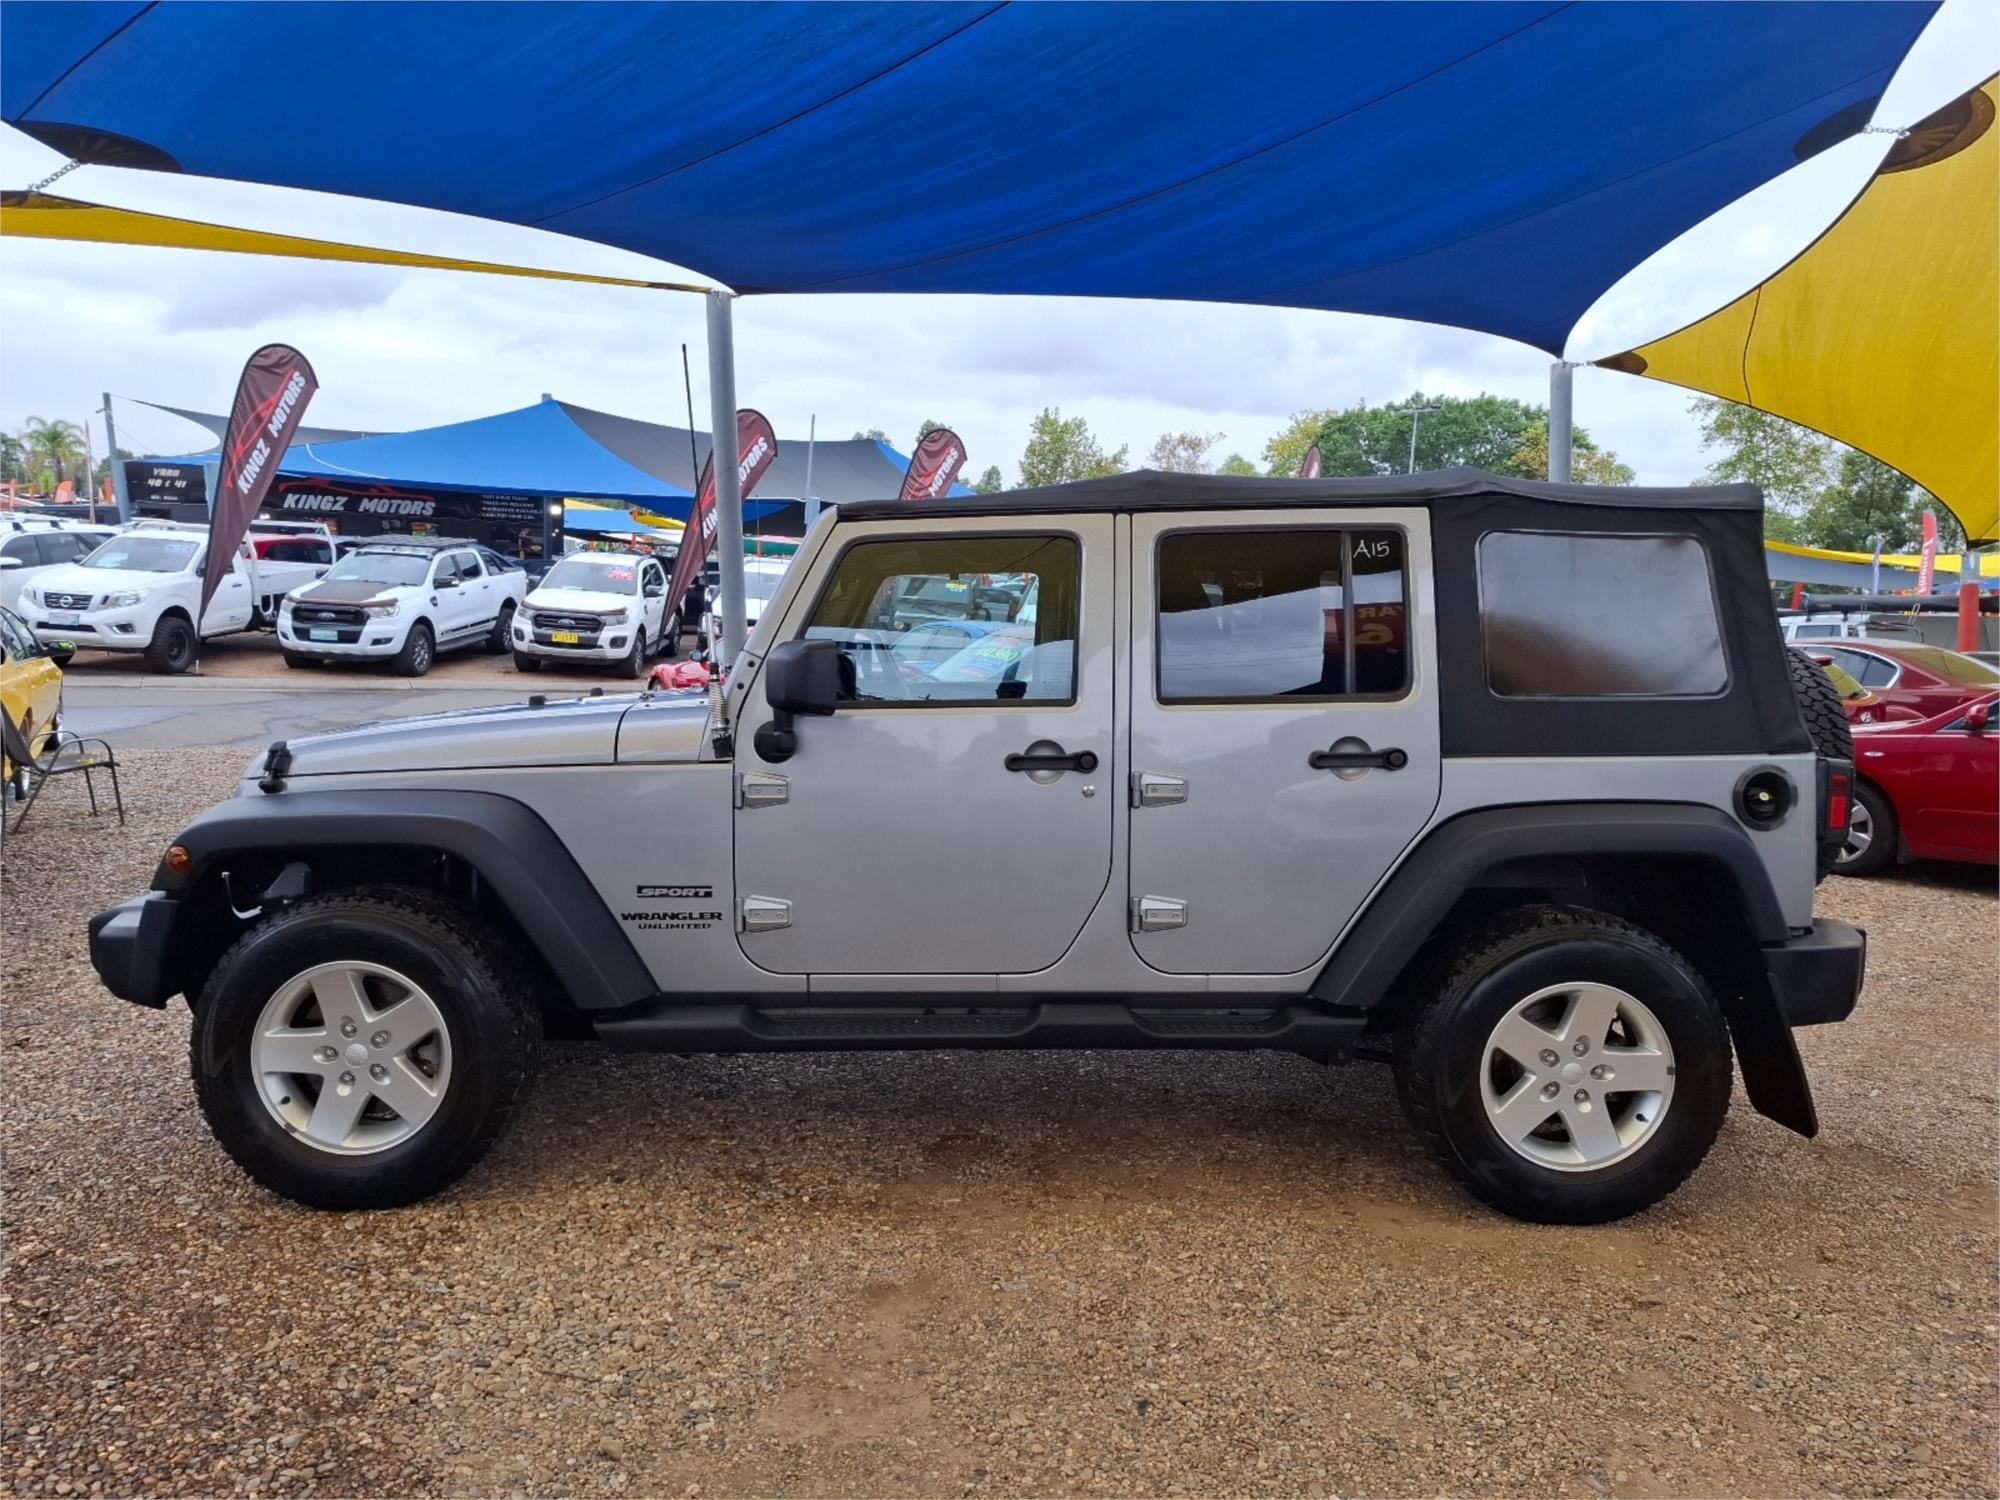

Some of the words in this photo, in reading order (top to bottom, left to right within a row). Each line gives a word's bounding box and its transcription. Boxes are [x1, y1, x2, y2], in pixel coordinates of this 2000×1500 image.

[238, 438, 271, 495] KINGZ
[267, 371, 306, 438] MOTORS
[928, 447, 959, 498] MOTORS
[702, 508, 718, 539] KIN
[738, 437, 768, 487] OTORS
[283, 493, 349, 511] KINGZ
[358, 497, 436, 516] MOTORS
[1353, 539, 1390, 558] A15
[637, 886, 712, 897] SPORT
[620, 912, 724, 921] WRANGLER
